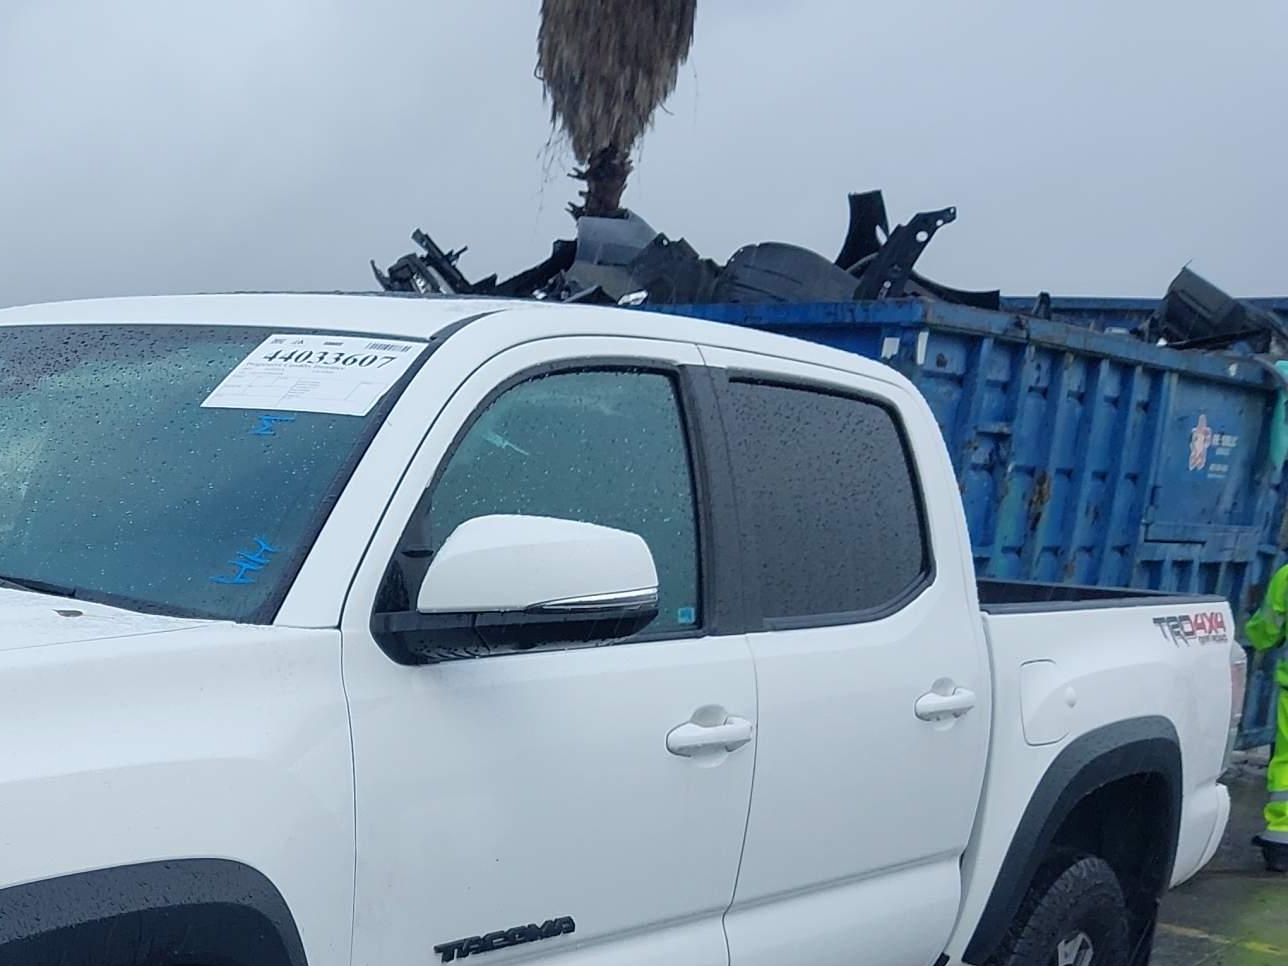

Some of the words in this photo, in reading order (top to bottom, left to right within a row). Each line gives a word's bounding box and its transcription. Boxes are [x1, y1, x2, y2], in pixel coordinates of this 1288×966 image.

[263, 350, 397, 369] 44033607
[1152, 615, 1196, 647] TRD
[433, 915, 576, 963] TACOMA
